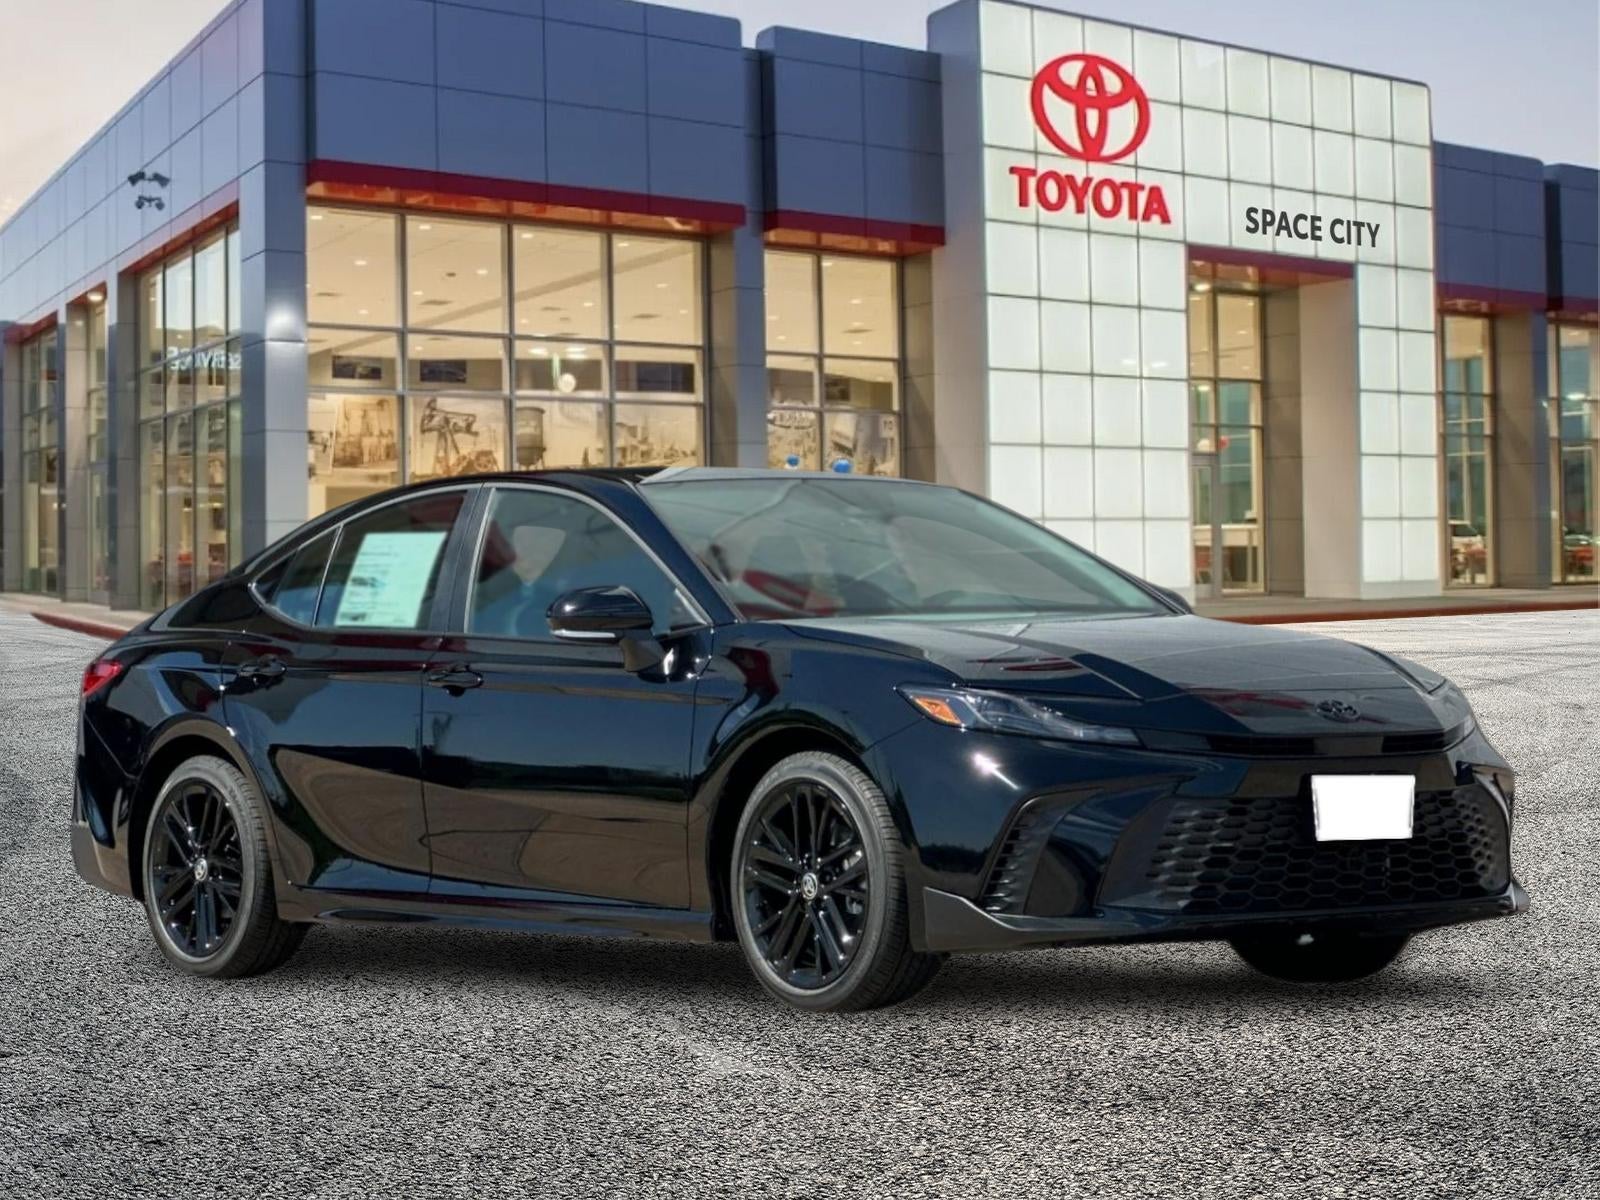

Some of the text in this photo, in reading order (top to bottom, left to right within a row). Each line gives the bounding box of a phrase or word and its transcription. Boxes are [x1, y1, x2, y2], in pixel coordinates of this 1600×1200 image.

[1008, 165, 1171, 225] TOYOTA
[1245, 206, 1381, 248] SPACE CITY
